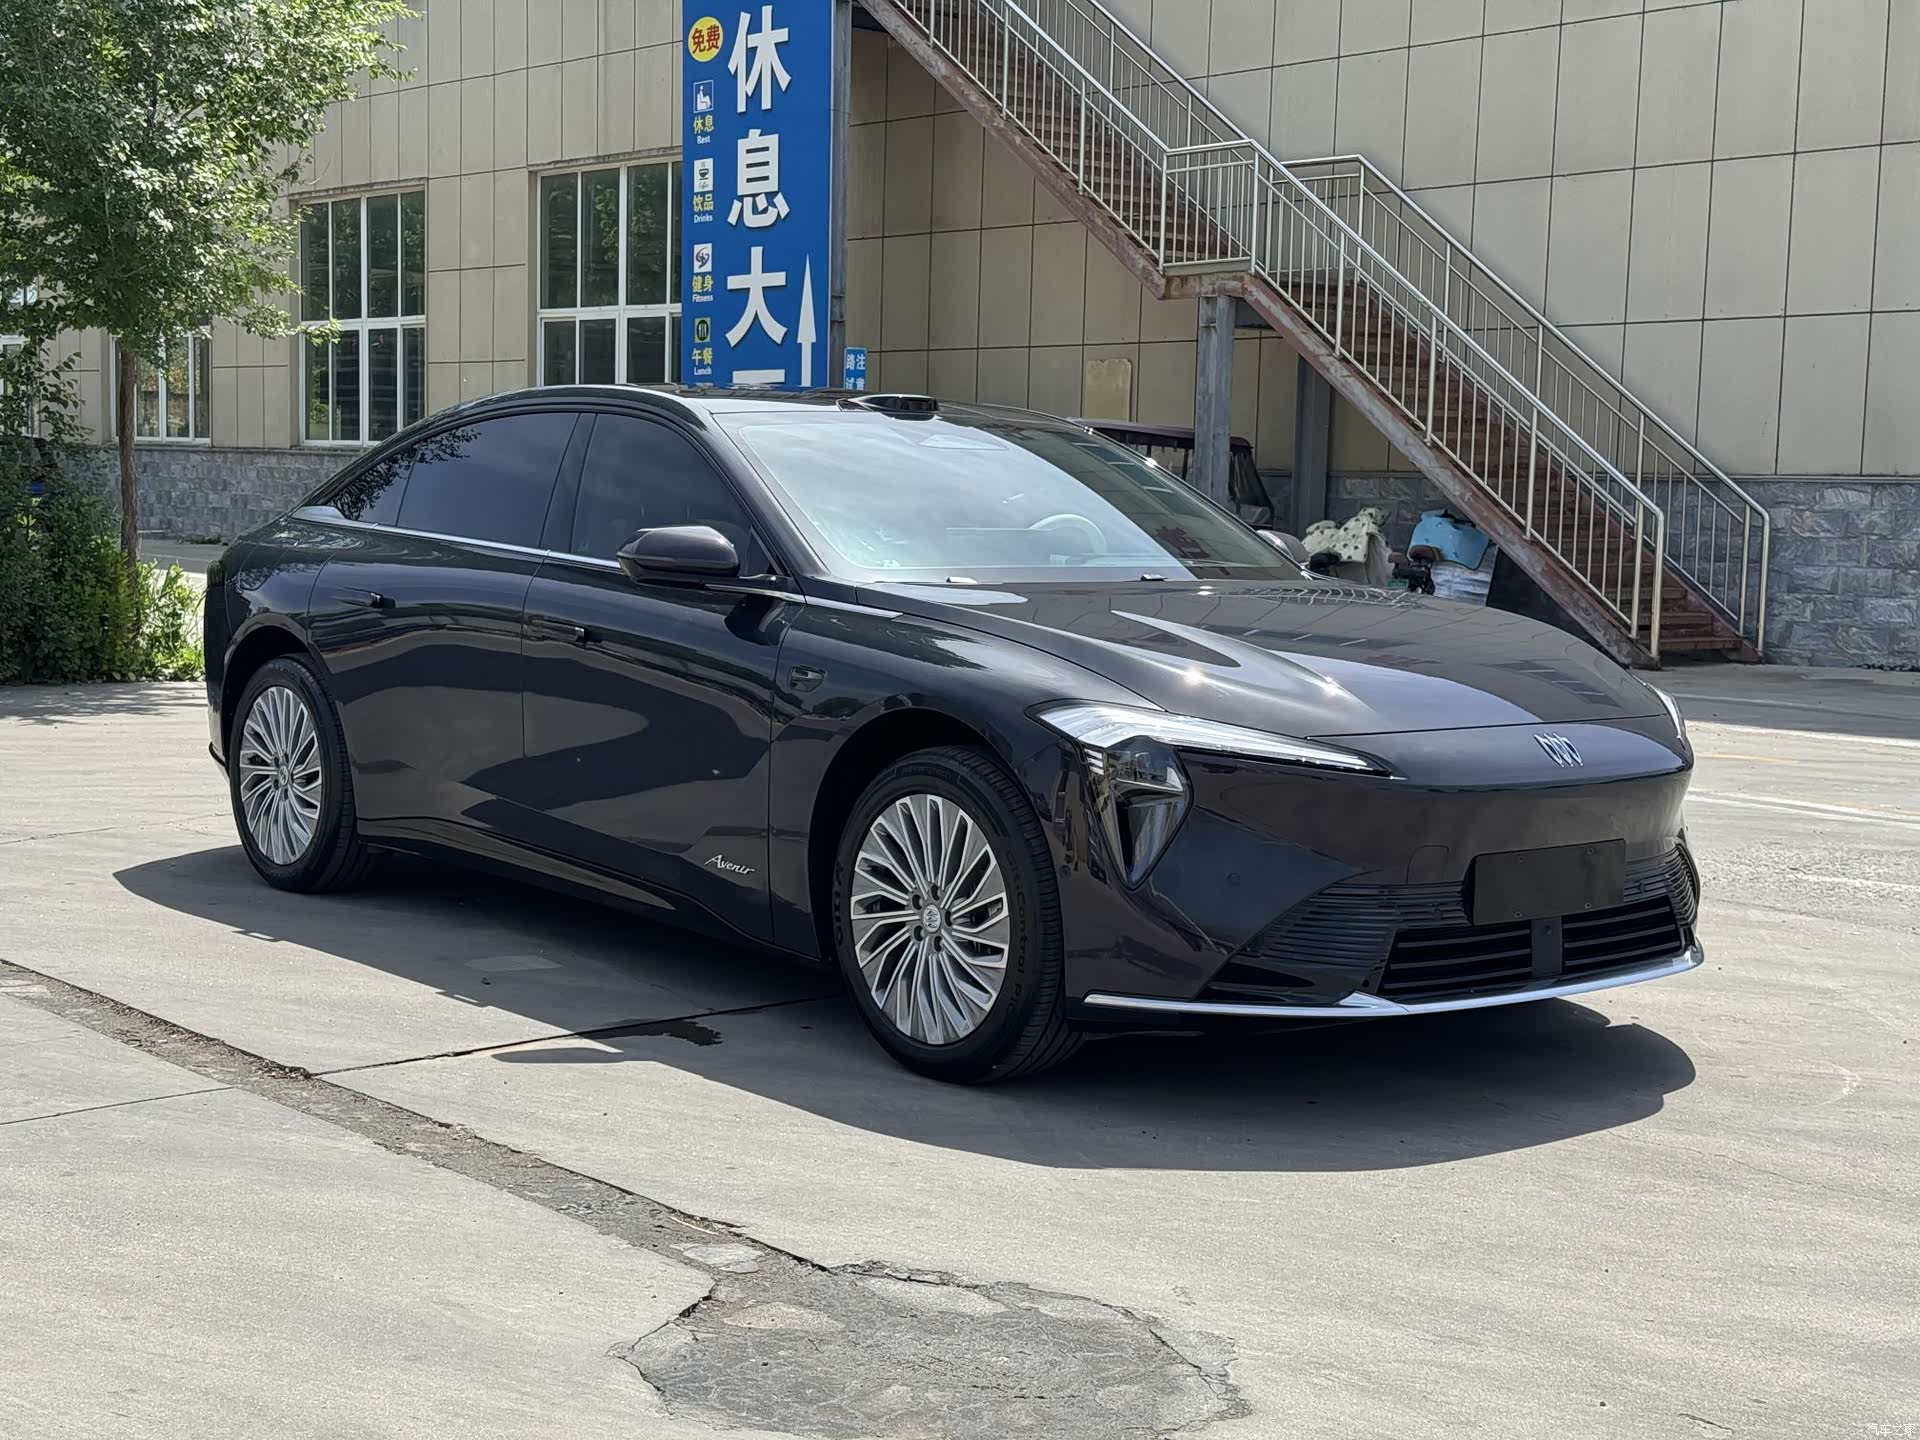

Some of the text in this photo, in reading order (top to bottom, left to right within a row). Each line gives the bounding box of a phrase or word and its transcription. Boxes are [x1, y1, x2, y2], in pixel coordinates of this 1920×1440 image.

[691, 24, 721, 54] 免费
[693, 115, 714, 134] 休息
[693, 193, 714, 212] 饮品
[725, 5, 791, 383] 休息大
[693, 214, 713, 223] Drinks
[692, 274, 714, 293] 健身
[692, 294, 714, 302] Fitness
[692, 347, 713, 365] 午餐
[694, 366, 712, 375] Lunch
[704, 854, 756, 874] Avenir
